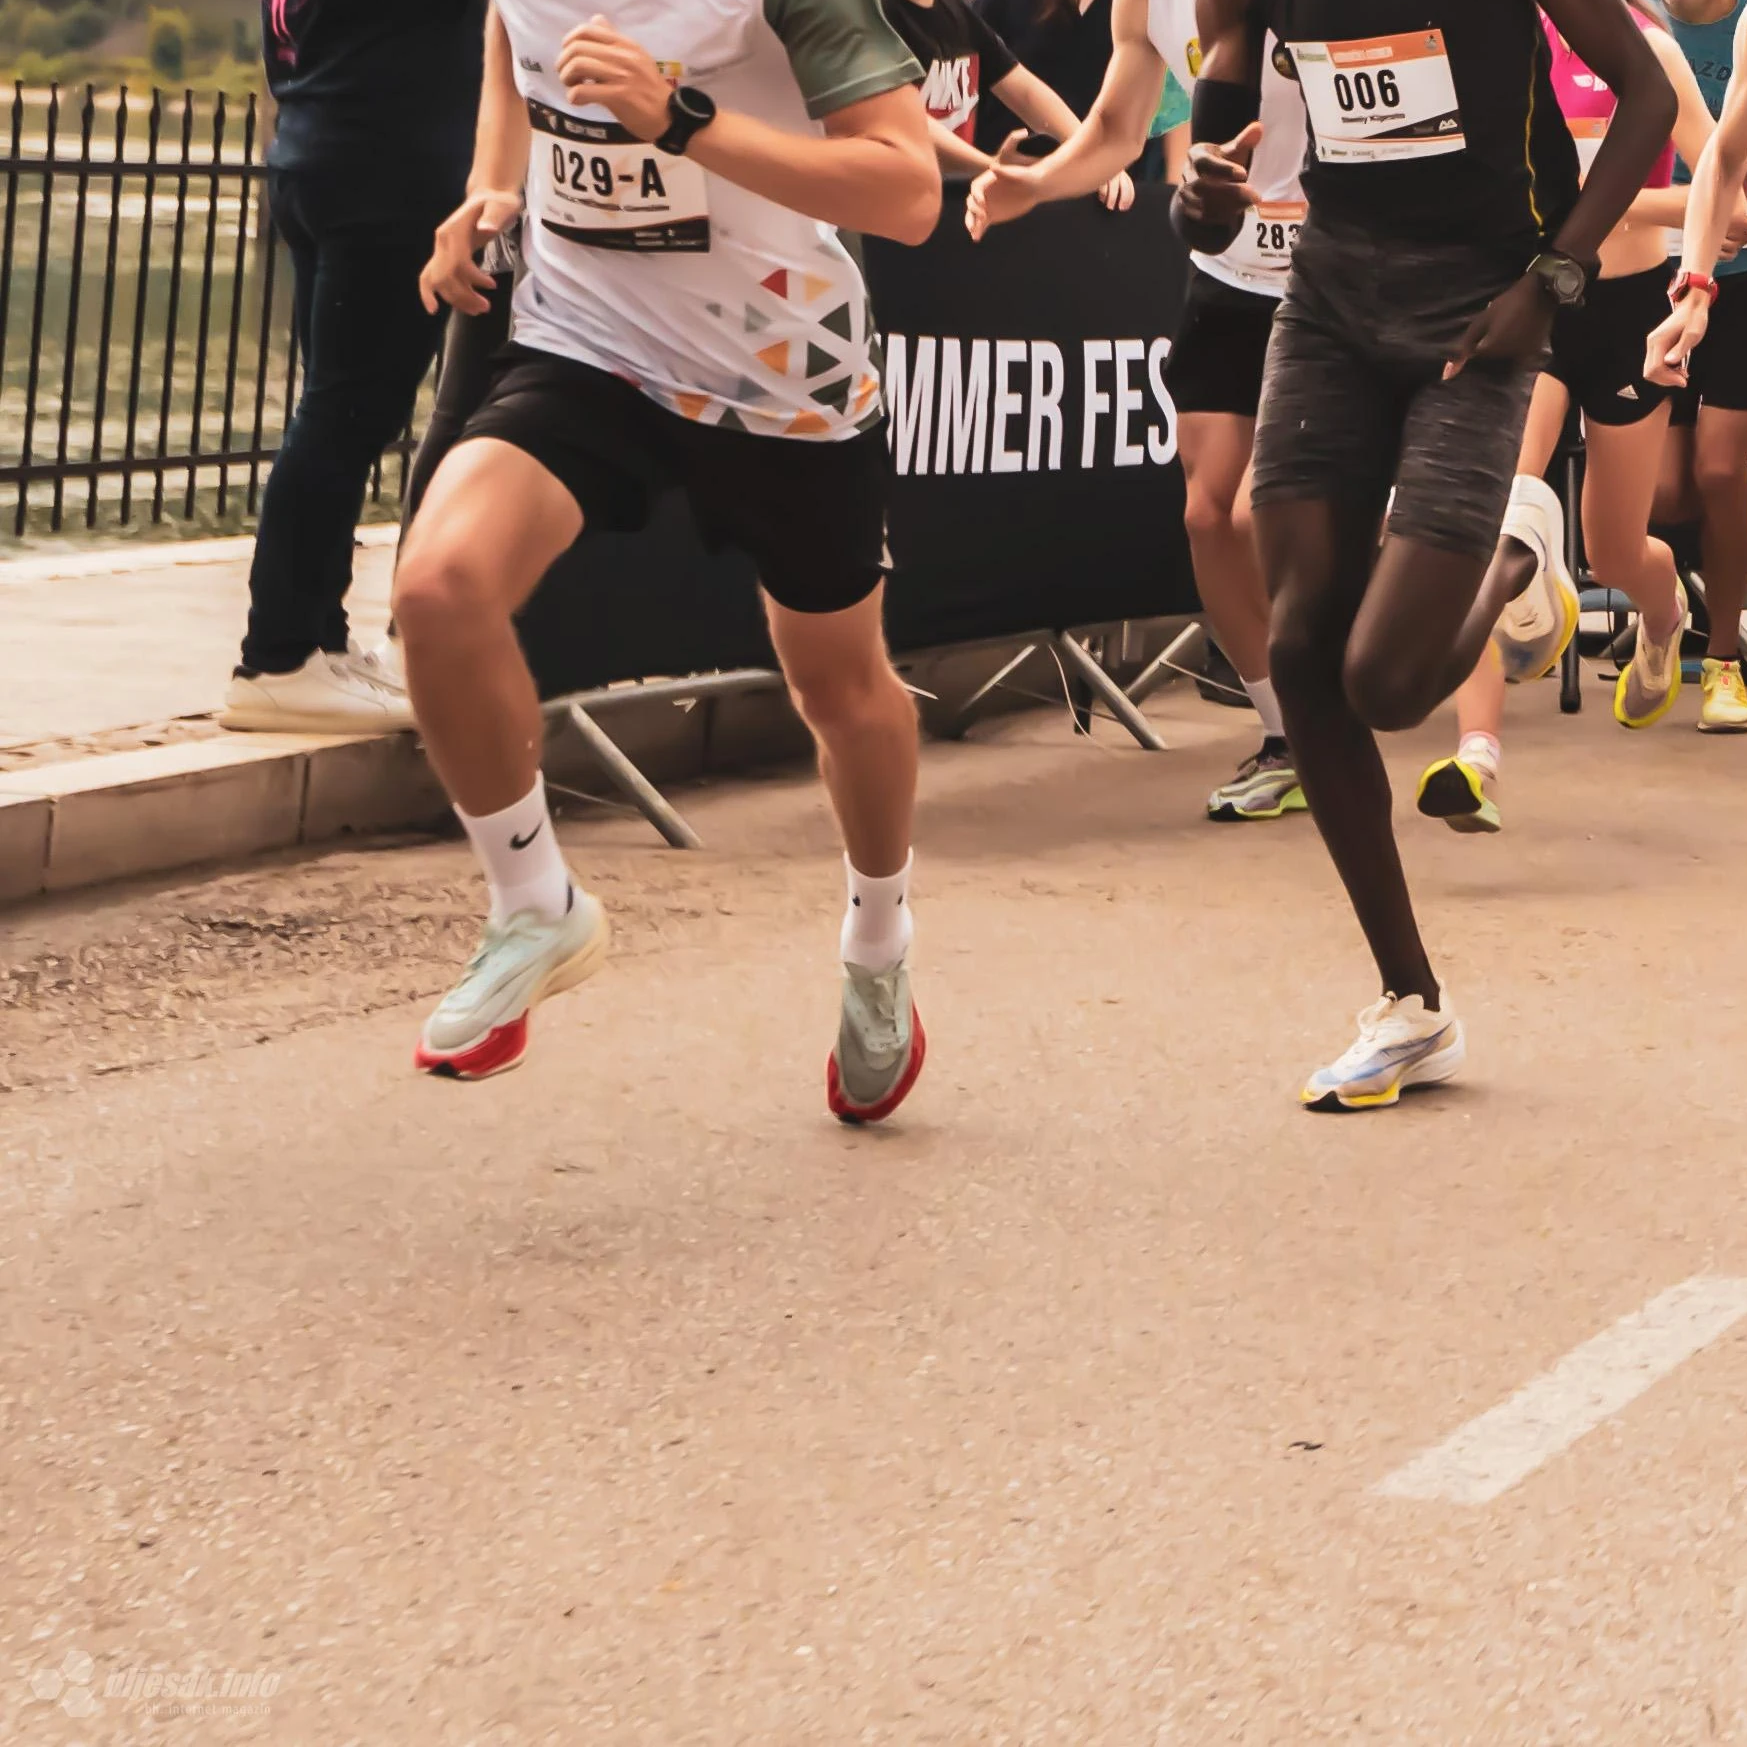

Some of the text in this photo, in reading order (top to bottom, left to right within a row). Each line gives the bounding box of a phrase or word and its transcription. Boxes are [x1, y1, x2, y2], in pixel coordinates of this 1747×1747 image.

[1333, 69, 1401, 112] 006
[552, 143, 667, 198] 029-A
[886, 332, 1178, 476] MMER FES
